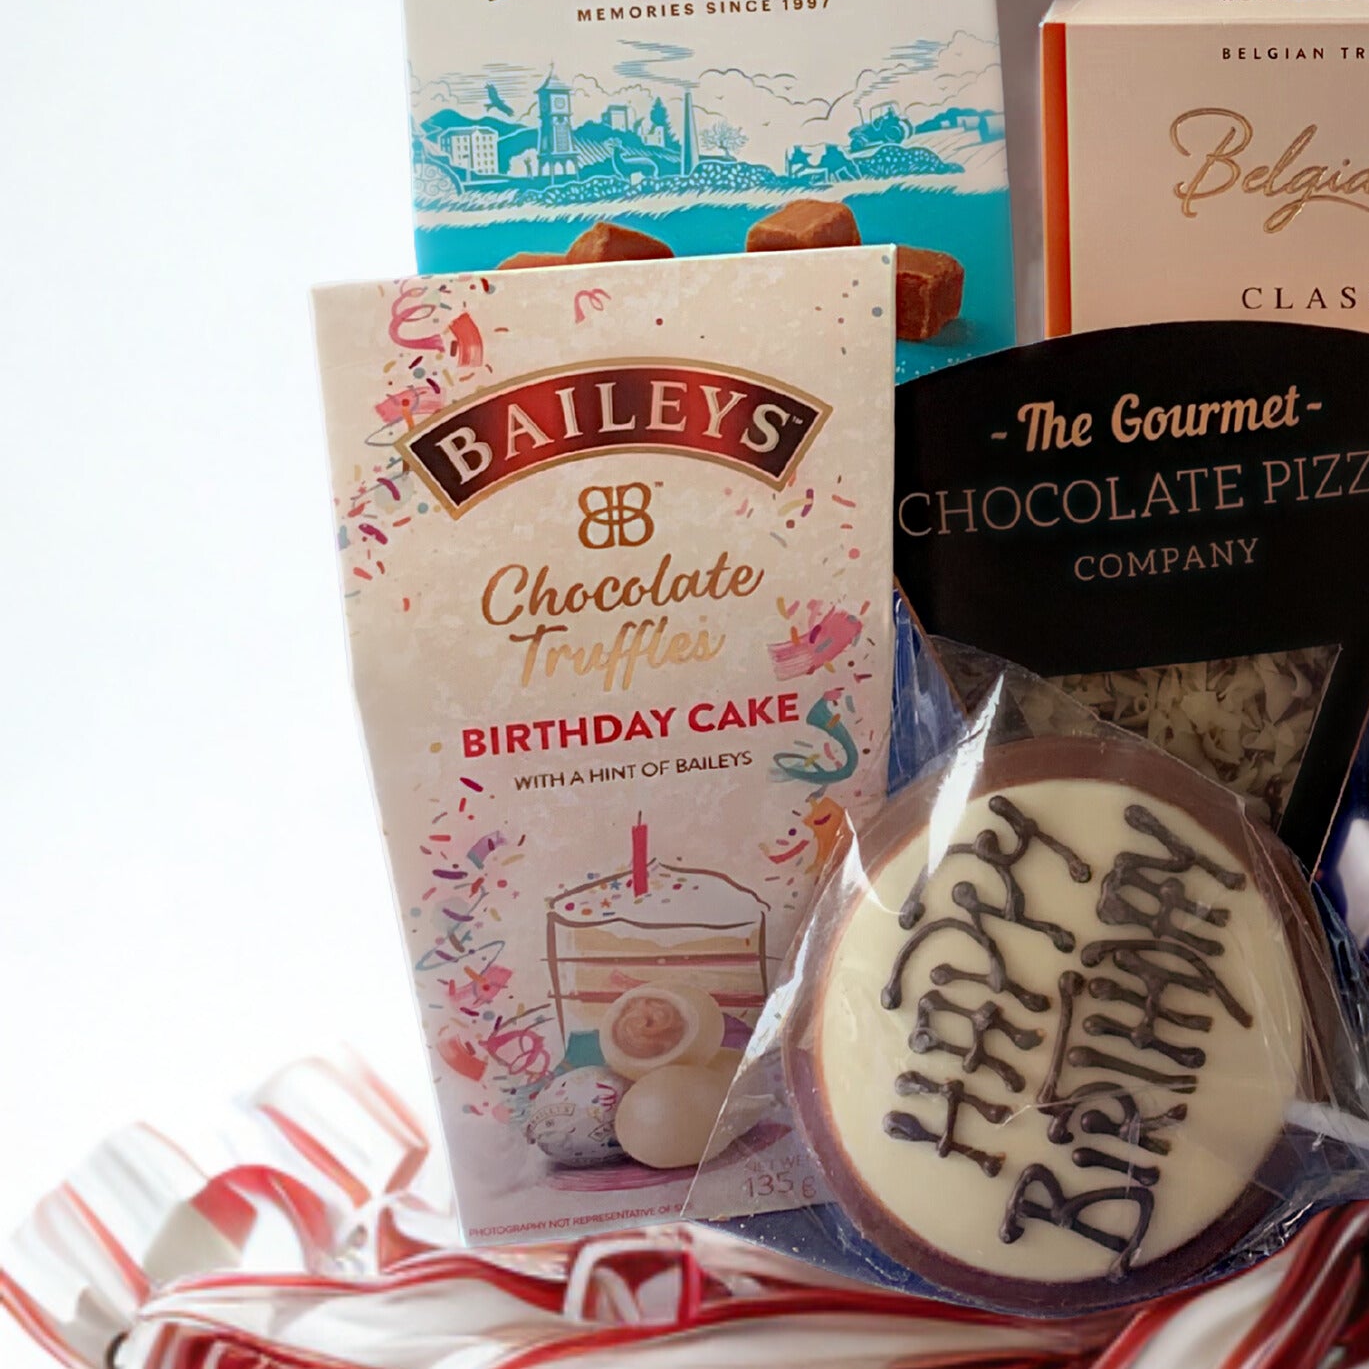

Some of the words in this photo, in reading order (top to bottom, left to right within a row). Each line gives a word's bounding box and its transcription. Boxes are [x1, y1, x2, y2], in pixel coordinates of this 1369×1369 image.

[577, 3, 694, 22] MEMORIES
[706, 0, 771, 15] SINCE
[1222, 47, 1324, 61] BELGIAN
[436, 380, 791, 484] BAILEYS
[898, 464, 1244, 537] CHOCOLATE
[481, 552, 765, 625] Chocolate
[1073, 537, 1258, 581] COMPANY
[509, 616, 726, 691] Truffles
[462, 707, 676, 759] BIRTHDAY
[687, 693, 800, 733] CAKE
[514, 772, 565, 791] WITH
[570, 771, 584, 785] A
[590, 764, 636, 782] HINT
[642, 761, 670, 777] OF
[676, 751, 752, 773] BAILEYS
[880, 794, 1092, 1177] HAPPY
[1000, 805, 1253, 1282] BIRTHDAY
[469, 1221, 546, 1237] PHOTOGRAPHY
[549, 1218, 570, 1229] NOT
[573, 1207, 655, 1225] REPRESENTATIVE
[658, 1205, 670, 1214] OF
